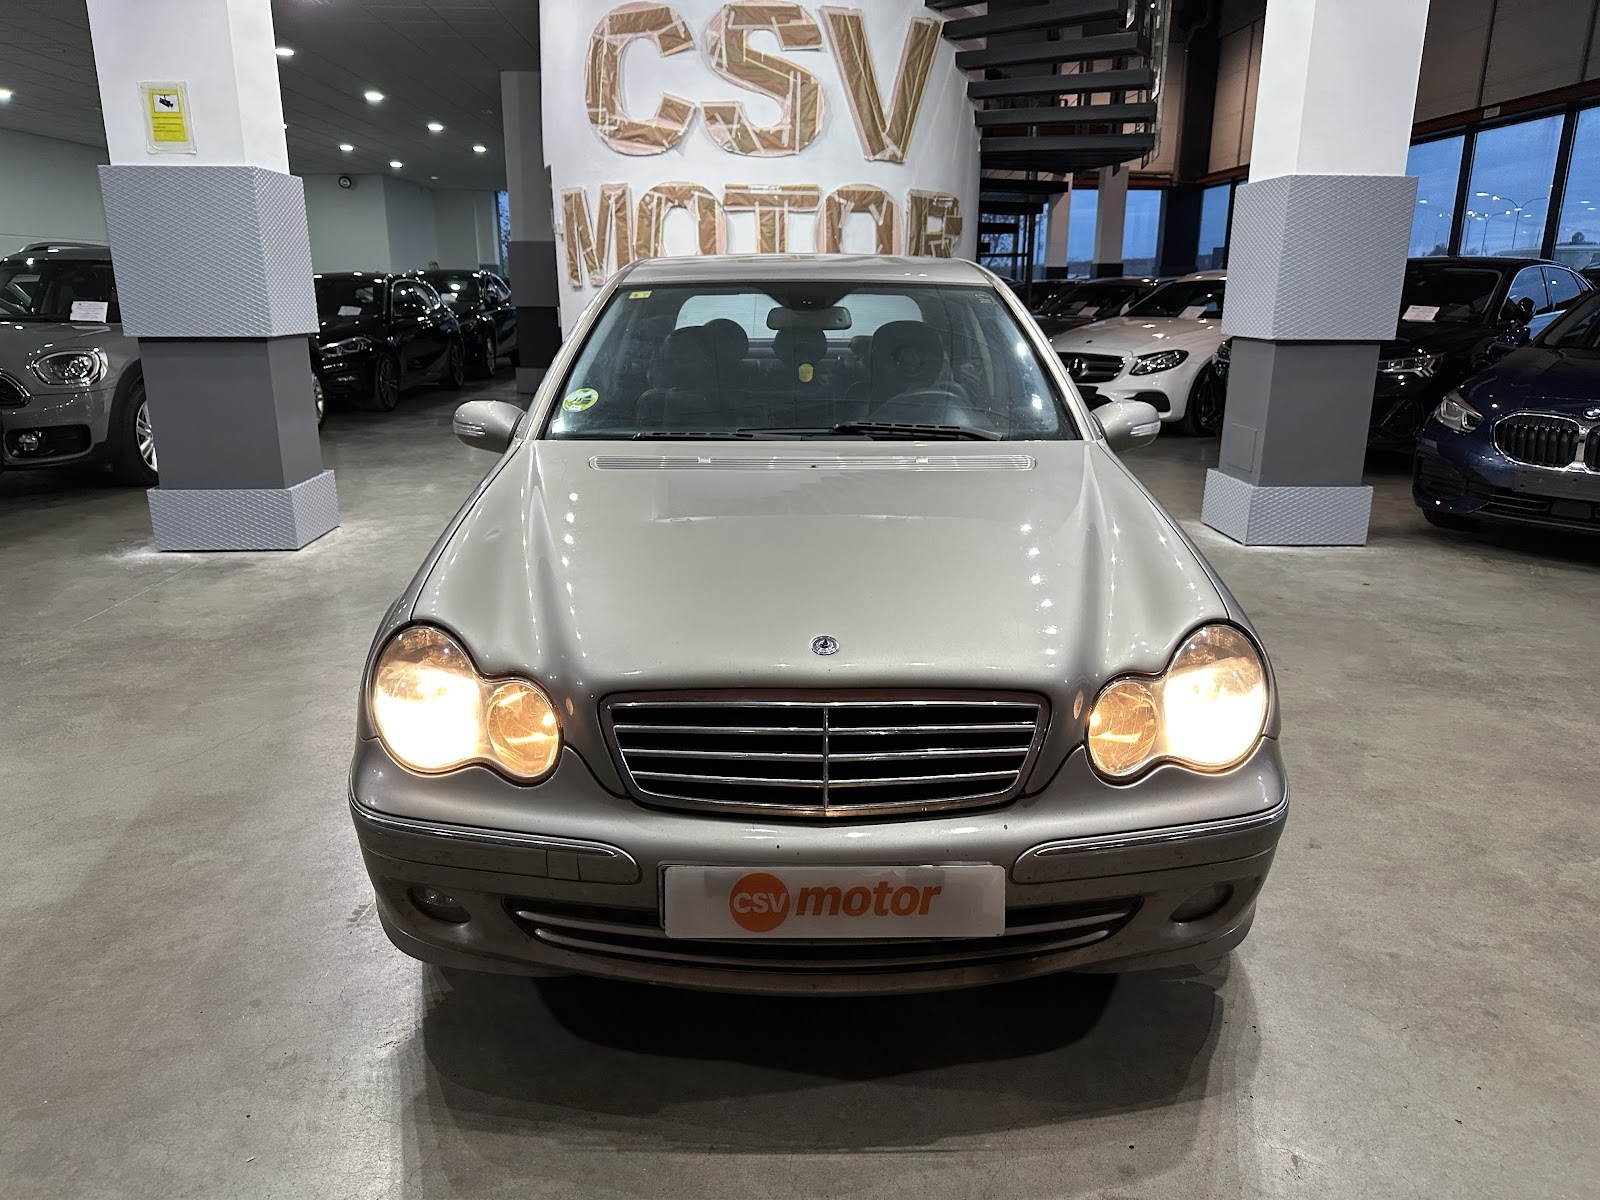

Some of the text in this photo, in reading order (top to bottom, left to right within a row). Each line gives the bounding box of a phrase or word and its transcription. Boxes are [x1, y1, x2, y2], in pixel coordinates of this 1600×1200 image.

[584, 1, 945, 163] CSV
[561, 181, 962, 287] MOTOR
[796, 881, 942, 917] motor
